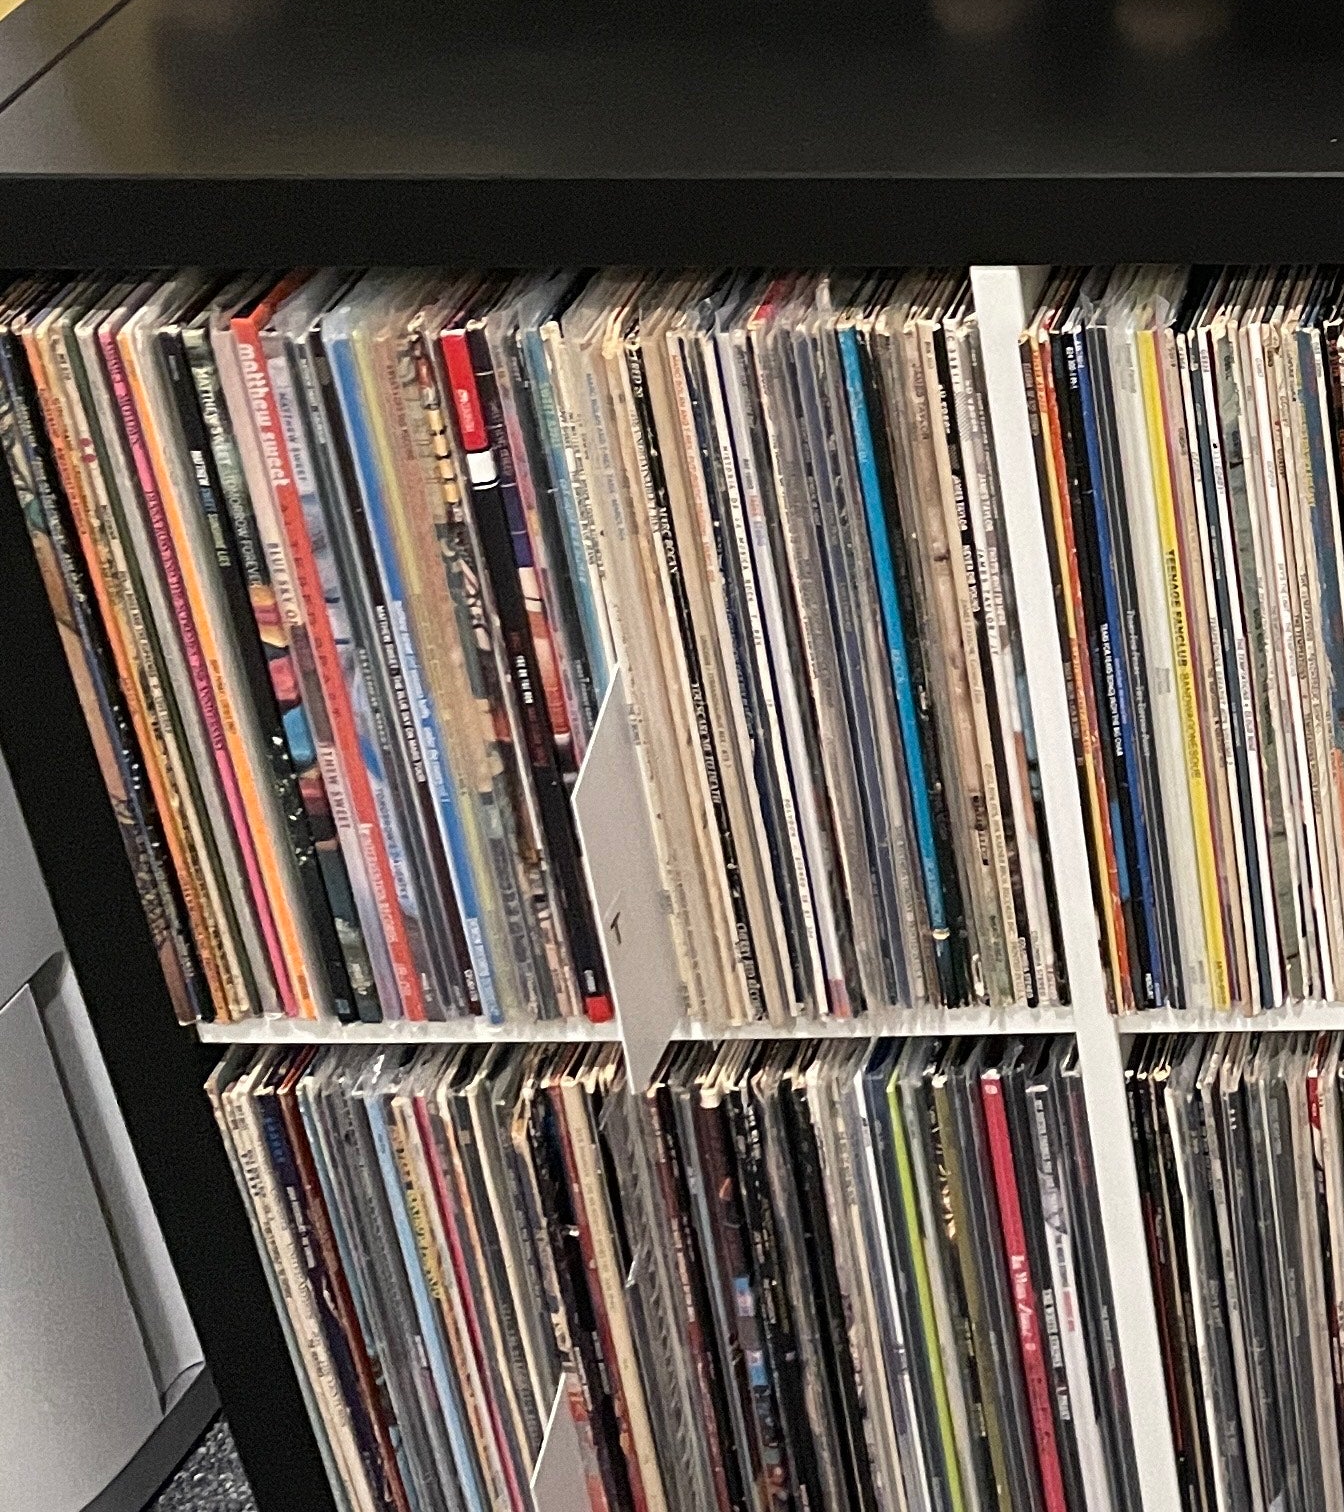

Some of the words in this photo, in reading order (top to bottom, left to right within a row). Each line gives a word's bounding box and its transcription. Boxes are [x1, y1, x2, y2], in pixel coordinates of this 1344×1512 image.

[193, 367, 222, 424] MATTHEW
[208, 425, 231, 464] SWEET
[237, 344, 274, 426] matthew
[261, 431, 291, 486] sweet
[276, 579, 295, 605] SKY
[1164, 549, 1180, 607] TEENAGE
[1171, 610, 1187, 667] FANCLUB
